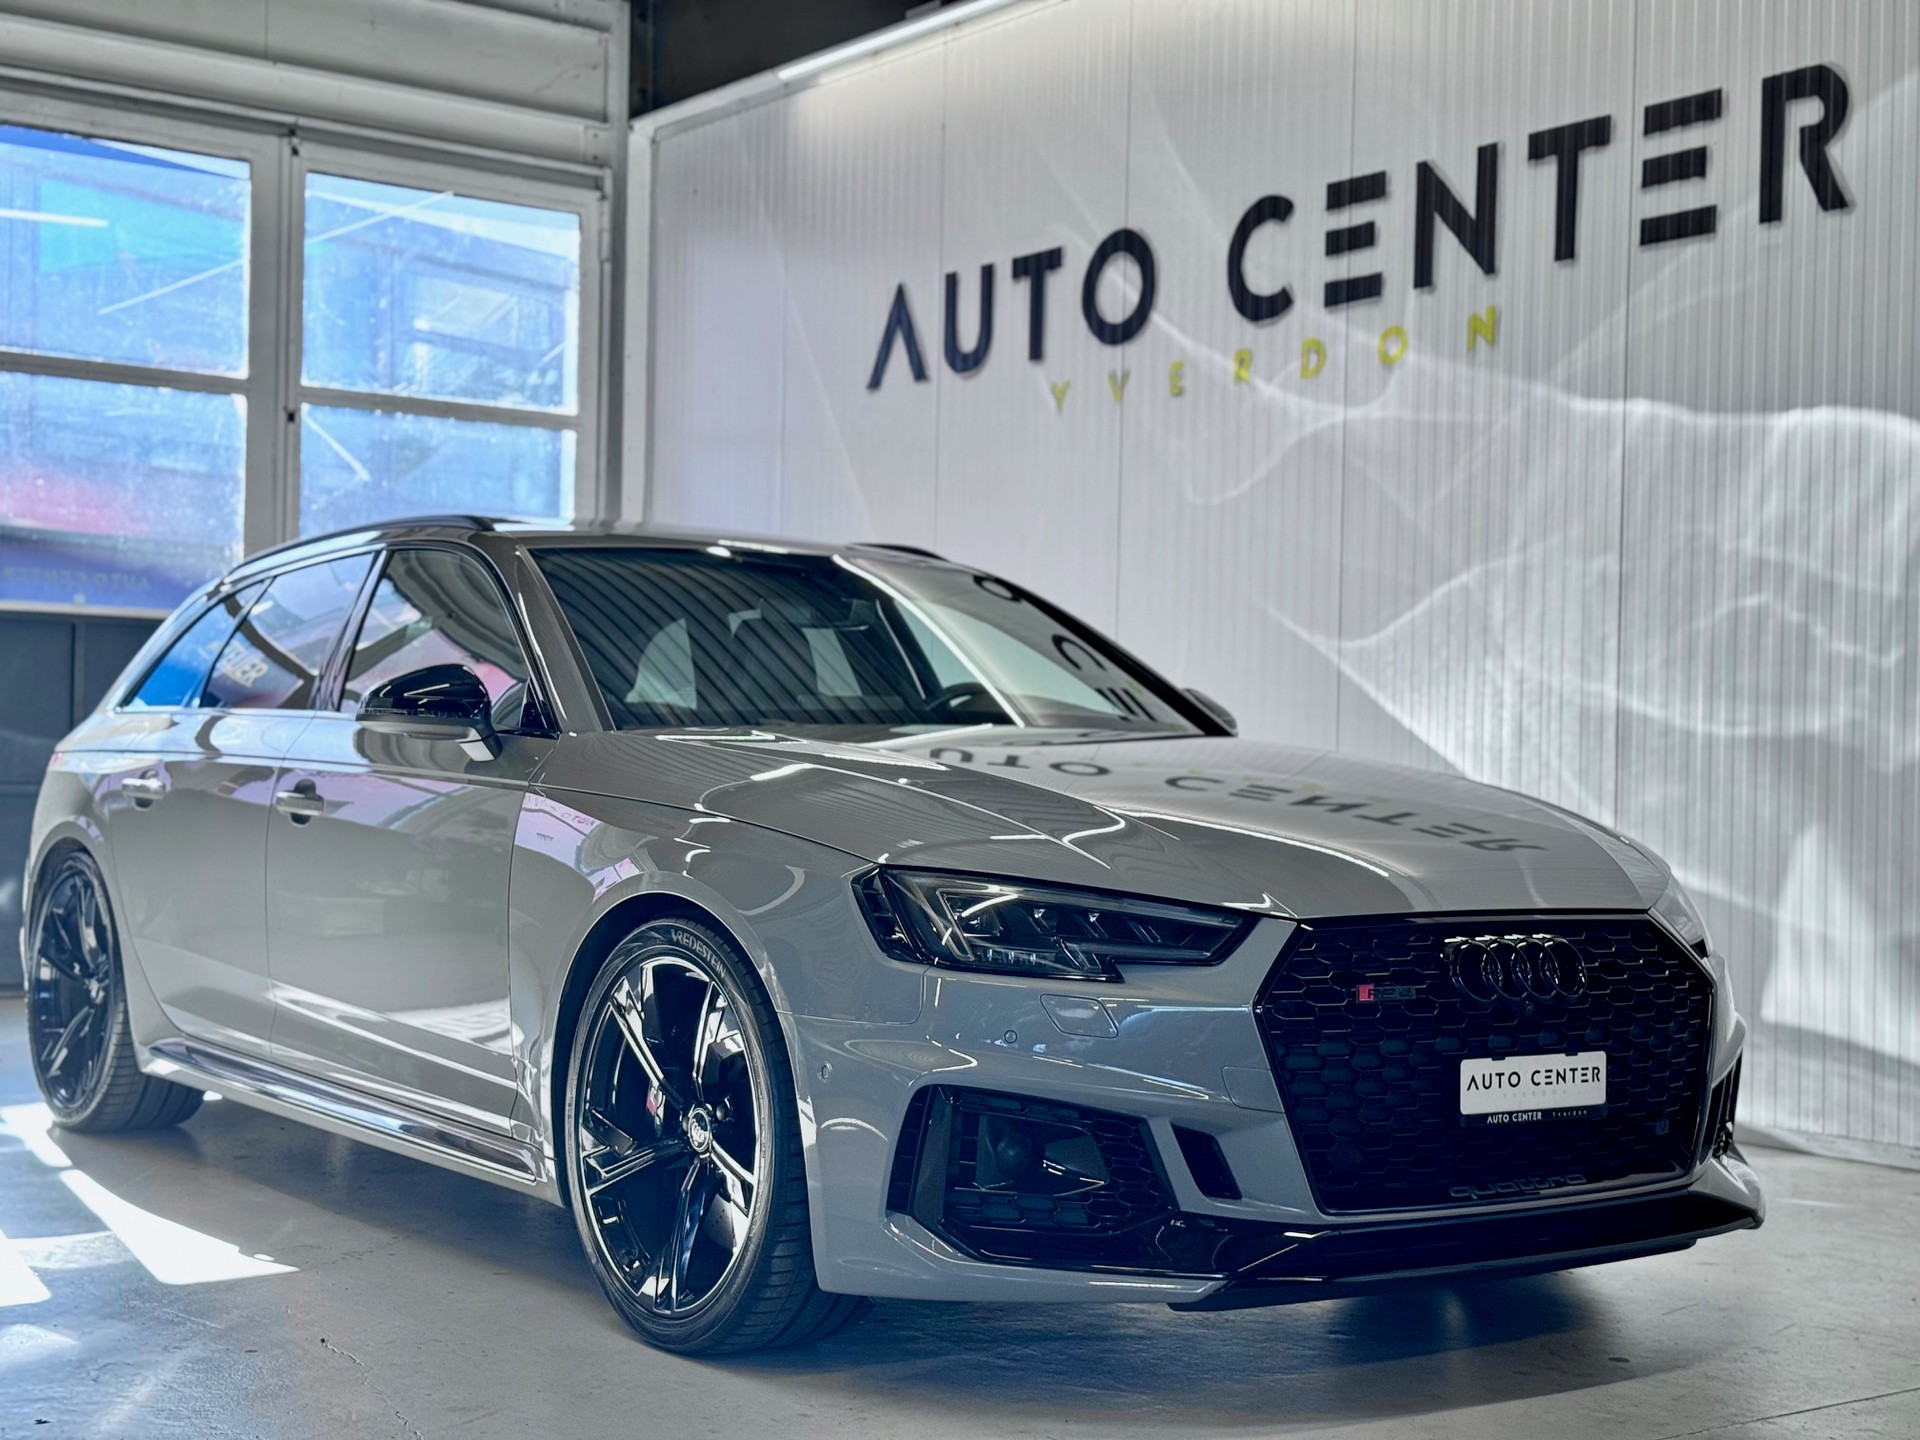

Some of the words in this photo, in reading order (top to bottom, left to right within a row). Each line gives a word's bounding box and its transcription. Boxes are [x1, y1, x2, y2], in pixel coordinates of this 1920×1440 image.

[867, 228, 1157, 391] AUTO
[1227, 62, 1853, 325] CENTER
[1051, 305, 1497, 414] YVERDON
[671, 928, 726, 978] VREDESTEIN
[1467, 1071, 1521, 1091] AUTO
[1531, 1066, 1600, 1087] CENTER
[1487, 1114, 1509, 1124] AUTO
[1512, 1111, 1542, 1122] CENTER
[1449, 1174, 1587, 1200] quattro
